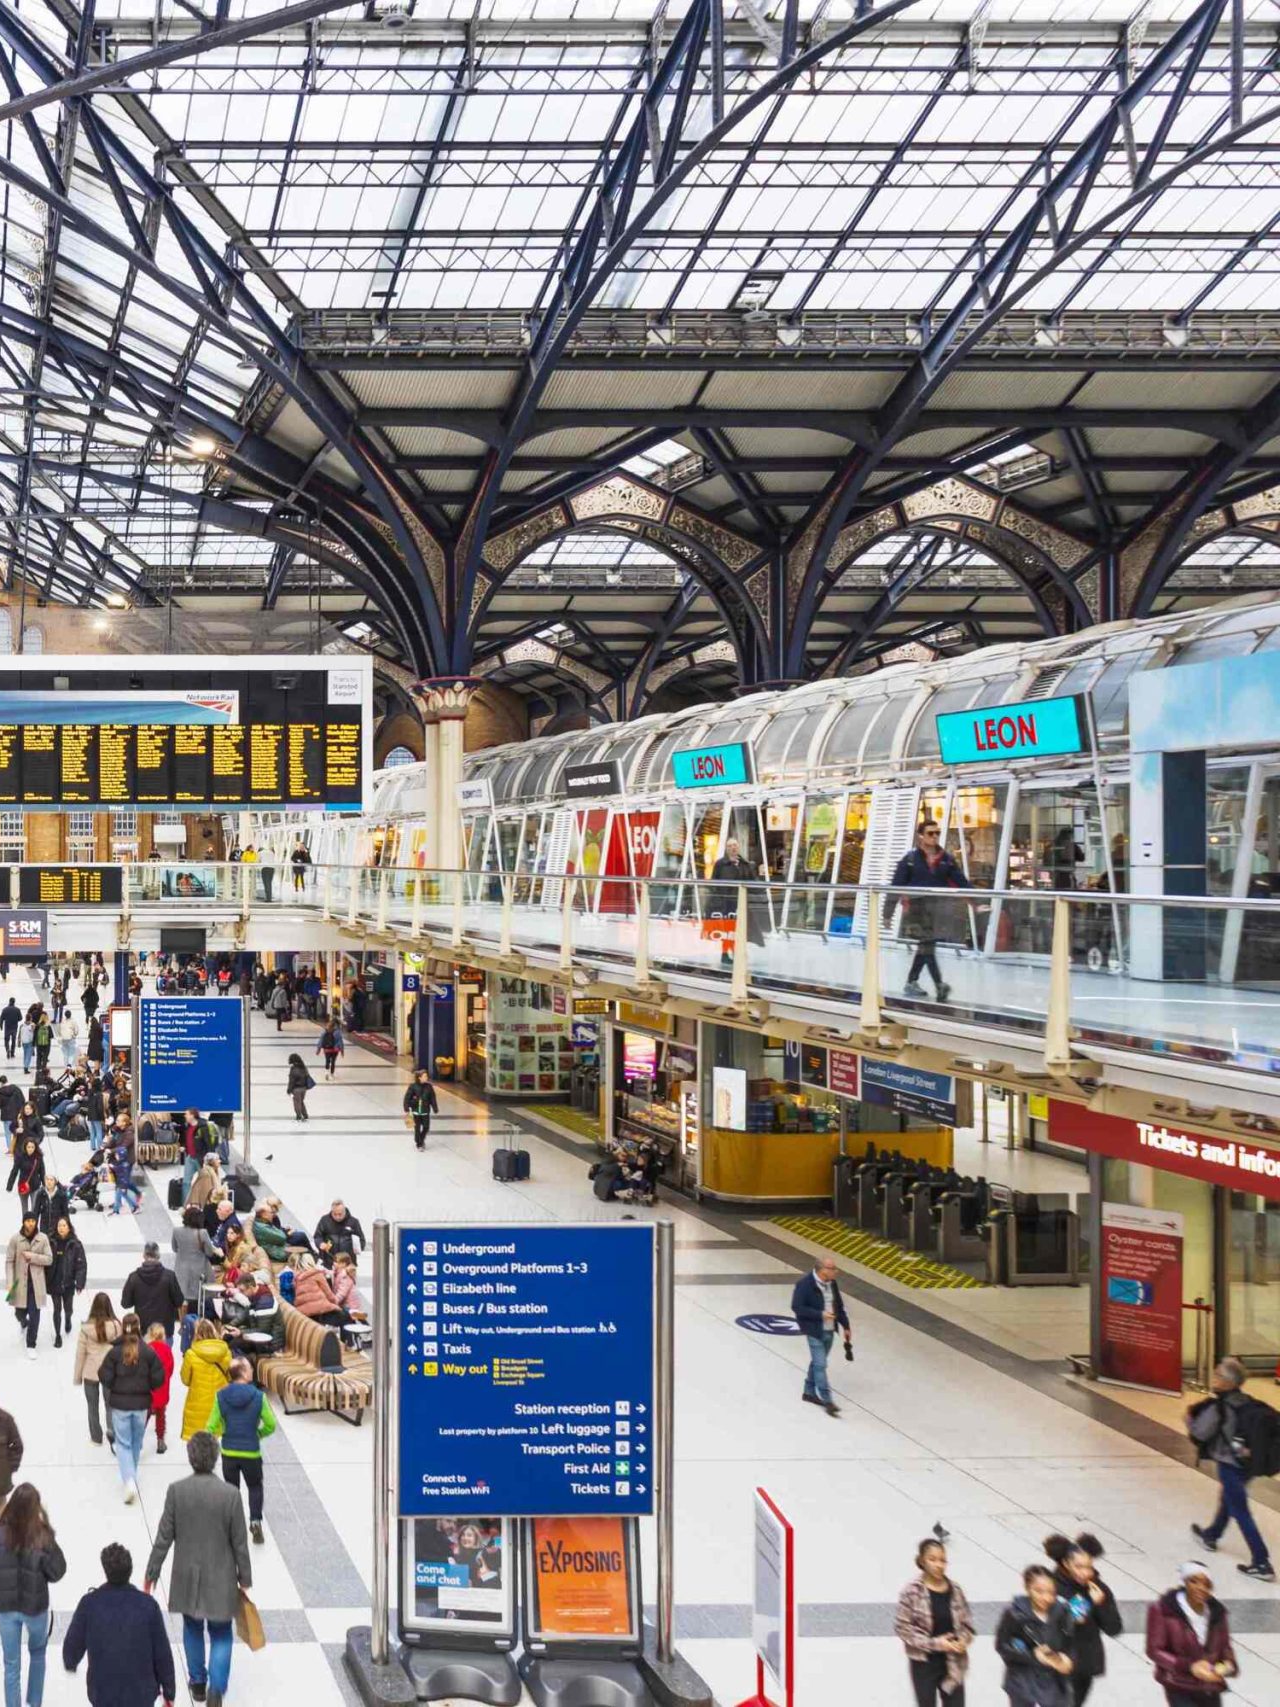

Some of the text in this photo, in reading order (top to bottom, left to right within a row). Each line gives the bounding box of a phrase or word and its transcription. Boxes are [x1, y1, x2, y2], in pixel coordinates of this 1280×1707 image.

[974, 713, 1037, 752] LEON
[691, 755, 725, 780] LEON
[407, 977, 415, 988] 8
[864, 1064, 936, 1091] London Liverpool Street
[1136, 1122, 1198, 1158] Tickets
[1200, 1143, 1236, 1167] and
[1108, 1233, 1143, 1246] Oyster
[443, 1243, 515, 1256] Underground
[443, 1263, 508, 1276] Overground
[511, 1262, 564, 1273] Platforms
[443, 1282, 516, 1294] Elizabeth line
[443, 1303, 548, 1314] Buses / Bus station
[443, 1323, 462, 1334] Lift
[464, 1326, 480, 1335] Way
[496, 1326, 542, 1335] Underground
[543, 1326, 556, 1334] and
[557, 1326, 570, 1334] Bus
[571, 1326, 596, 1334] station
[443, 1343, 471, 1354] Taxis
[443, 1364, 488, 1376] Way out
[515, 1404, 610, 1416] Station reception
[456, 1428, 486, 1436] property
[487, 1427, 496, 1436] by
[497, 1427, 528, 1435] platform
[541, 1423, 565, 1434] Left
[567, 1423, 610, 1436] luggage
[521, 1443, 610, 1456] Transport Police
[564, 1463, 610, 1474] First Aid
[423, 1474, 467, 1483] Connect to
[423, 1486, 490, 1495] Free Station WiFi
[570, 1483, 610, 1494] Tickets
[416, 1563, 446, 1574] Come
[416, 1575, 461, 1585] and chat
